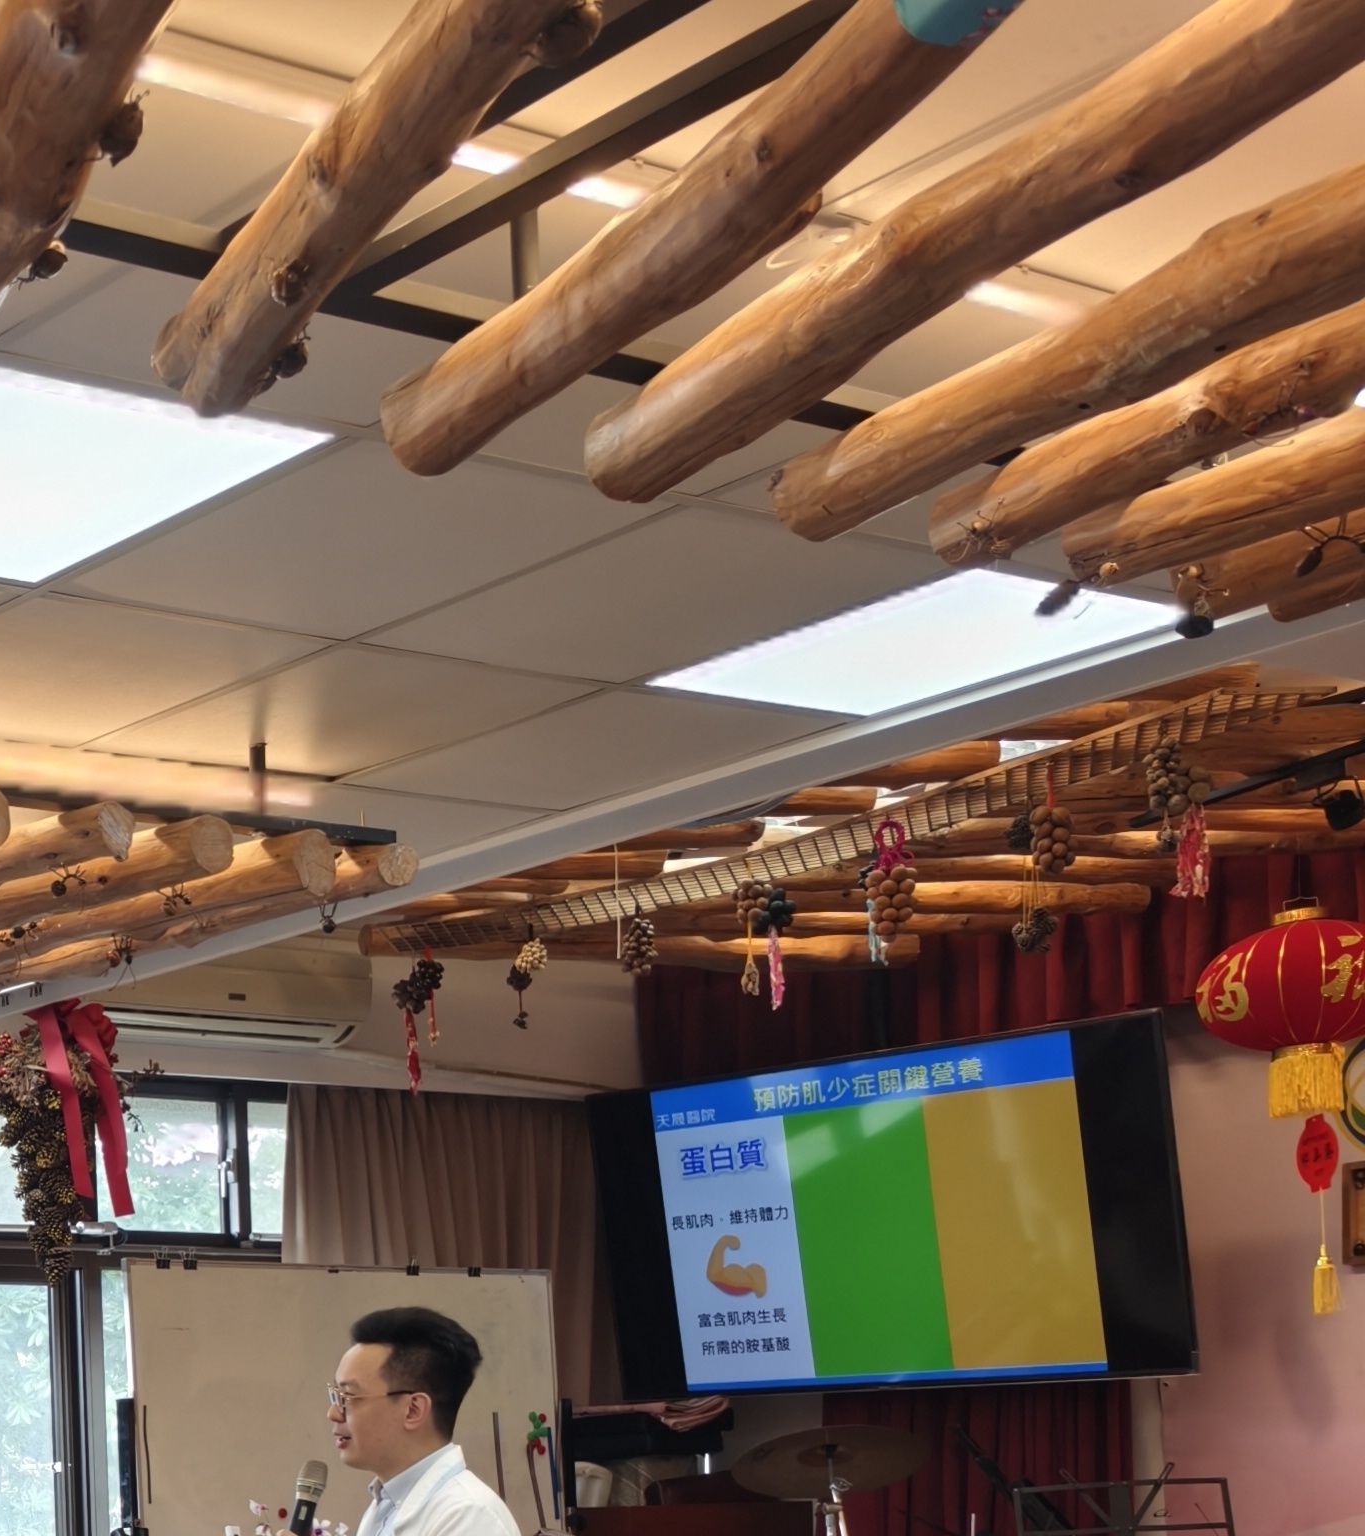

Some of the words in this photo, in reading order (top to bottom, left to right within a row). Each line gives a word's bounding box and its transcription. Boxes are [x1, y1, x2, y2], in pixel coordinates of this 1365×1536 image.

[753, 1056, 985, 1113] 預防肌少症關鍵營養
[679, 1138, 767, 1178] 蛋白質
[698, 1307, 788, 1329] 富含肌肉生長
[701, 1336, 791, 1357] 所需的胺基酸
